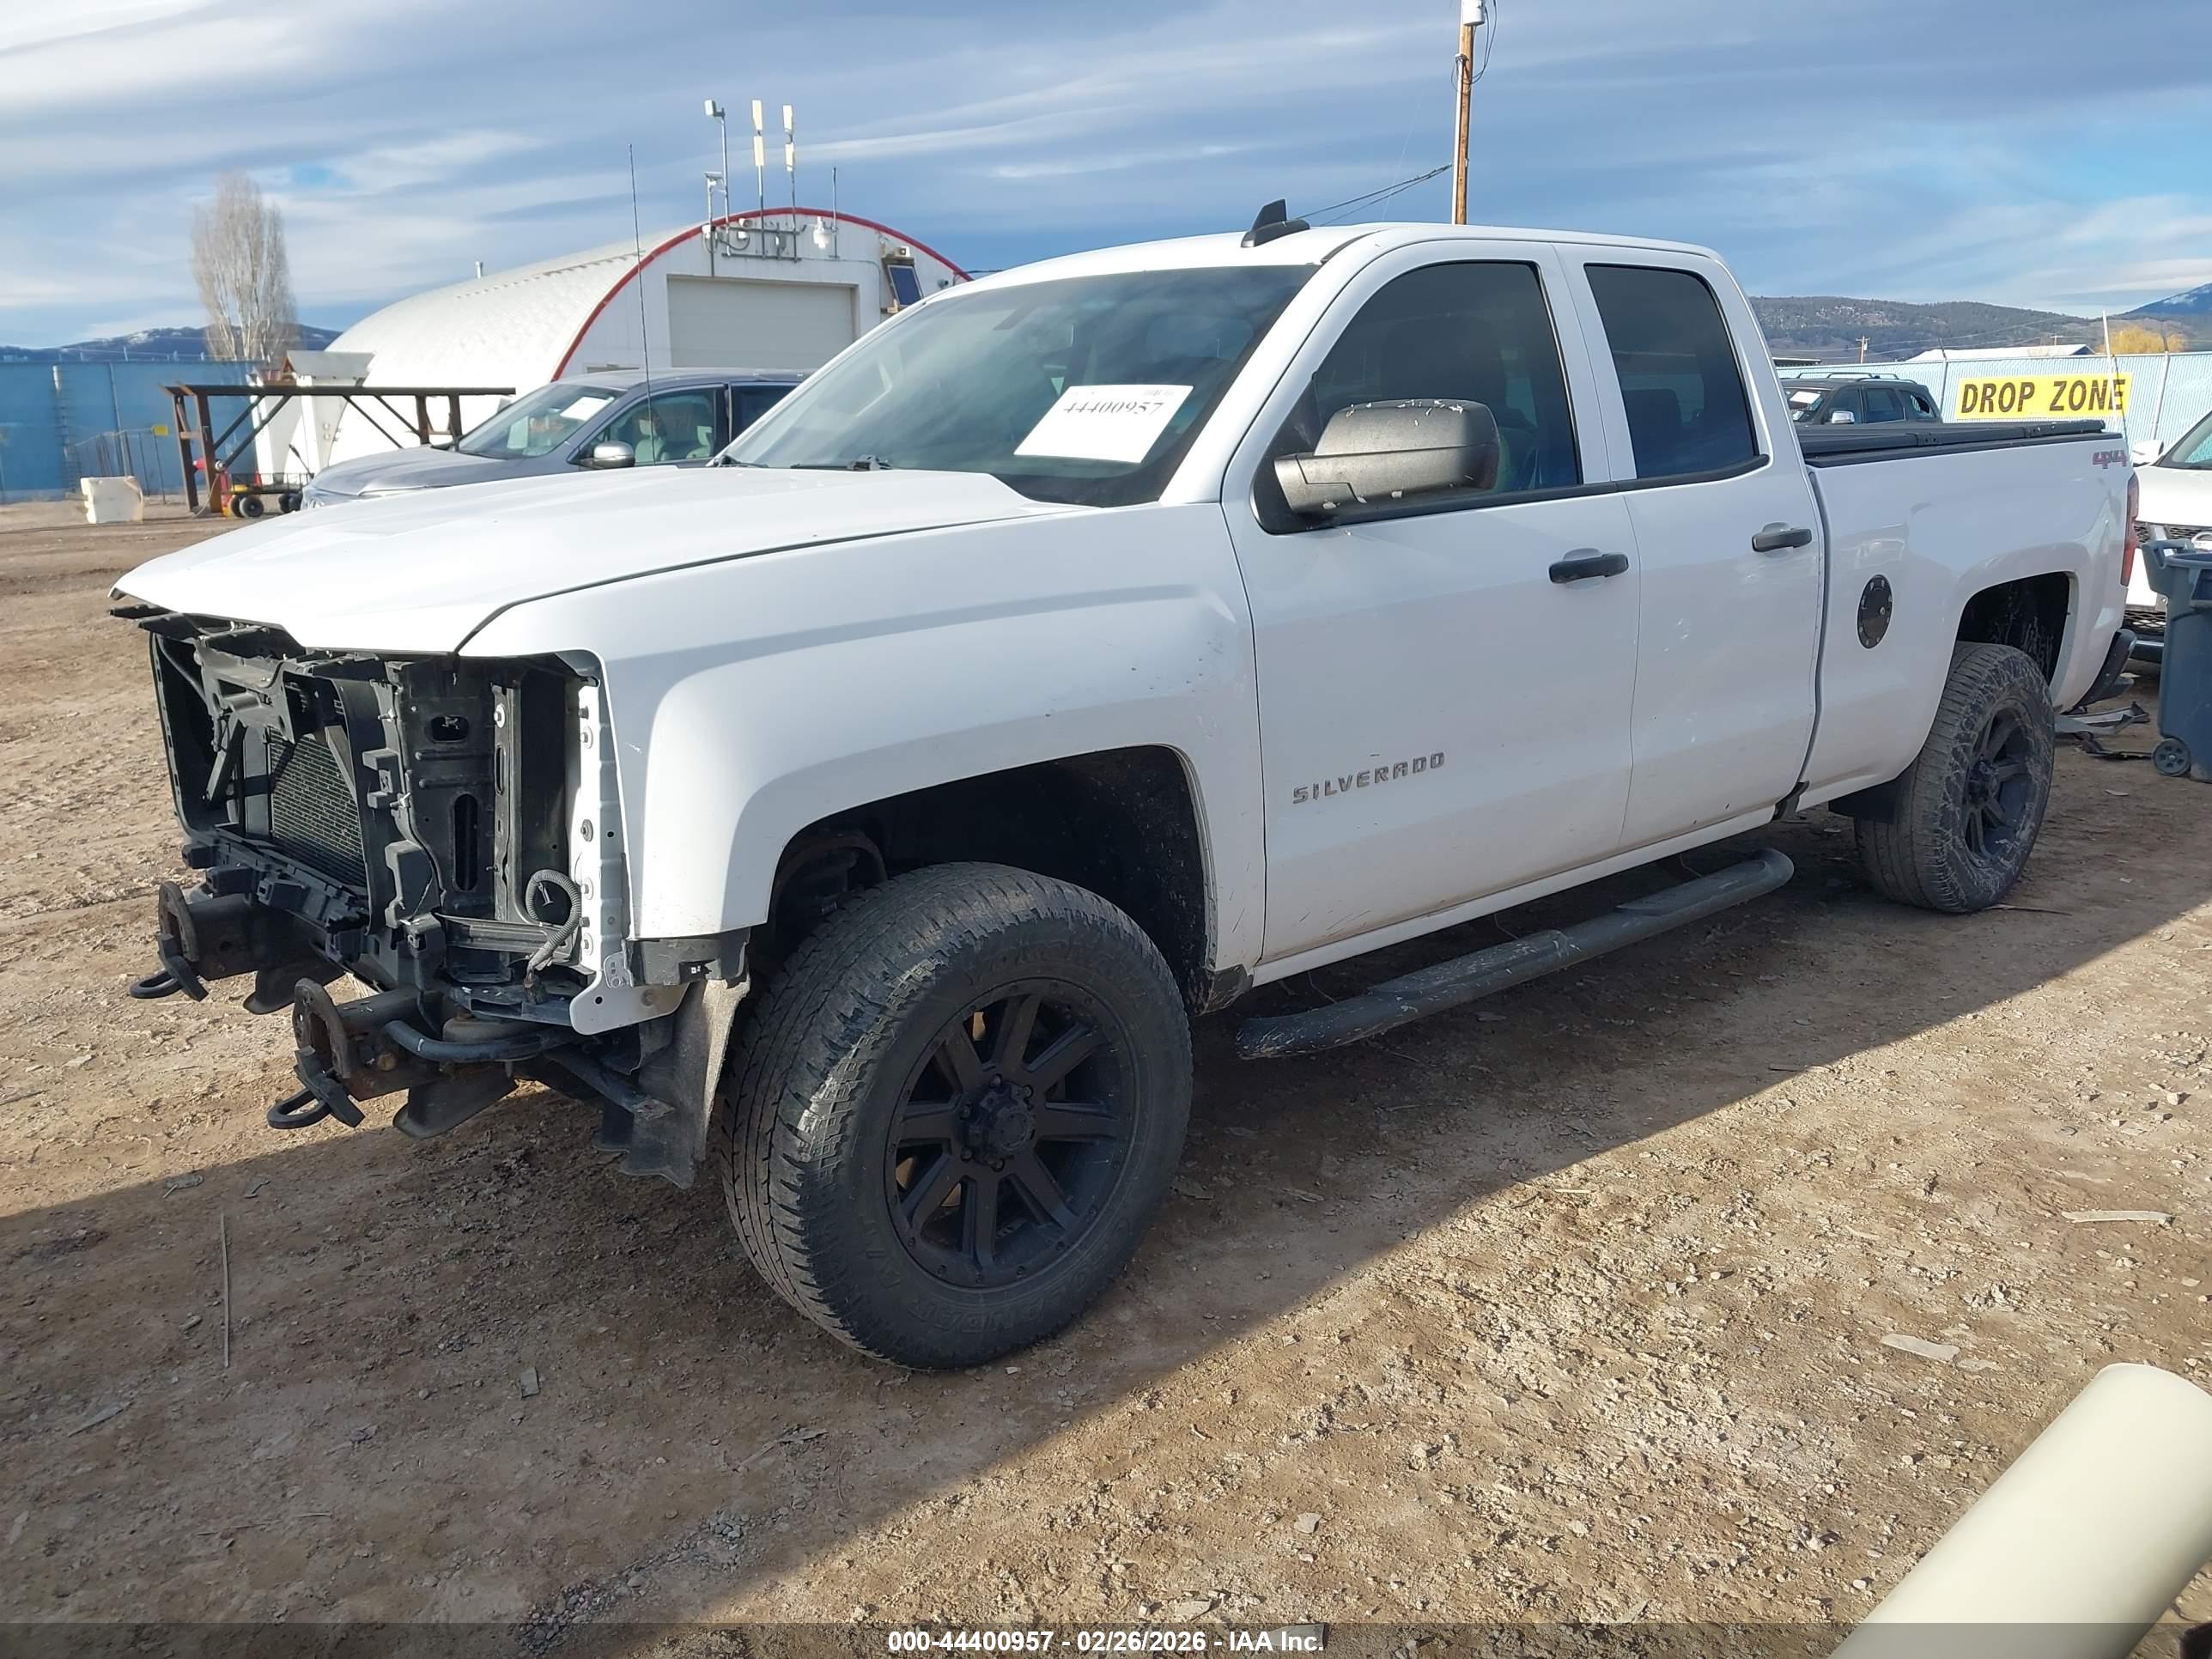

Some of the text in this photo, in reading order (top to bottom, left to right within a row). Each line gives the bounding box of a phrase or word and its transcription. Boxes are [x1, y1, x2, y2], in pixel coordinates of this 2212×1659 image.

[1064, 401, 1164, 415] 44400957
[1961, 379, 2126, 414] DROP ZONE
[1292, 751, 1445, 805] SILVERADO
